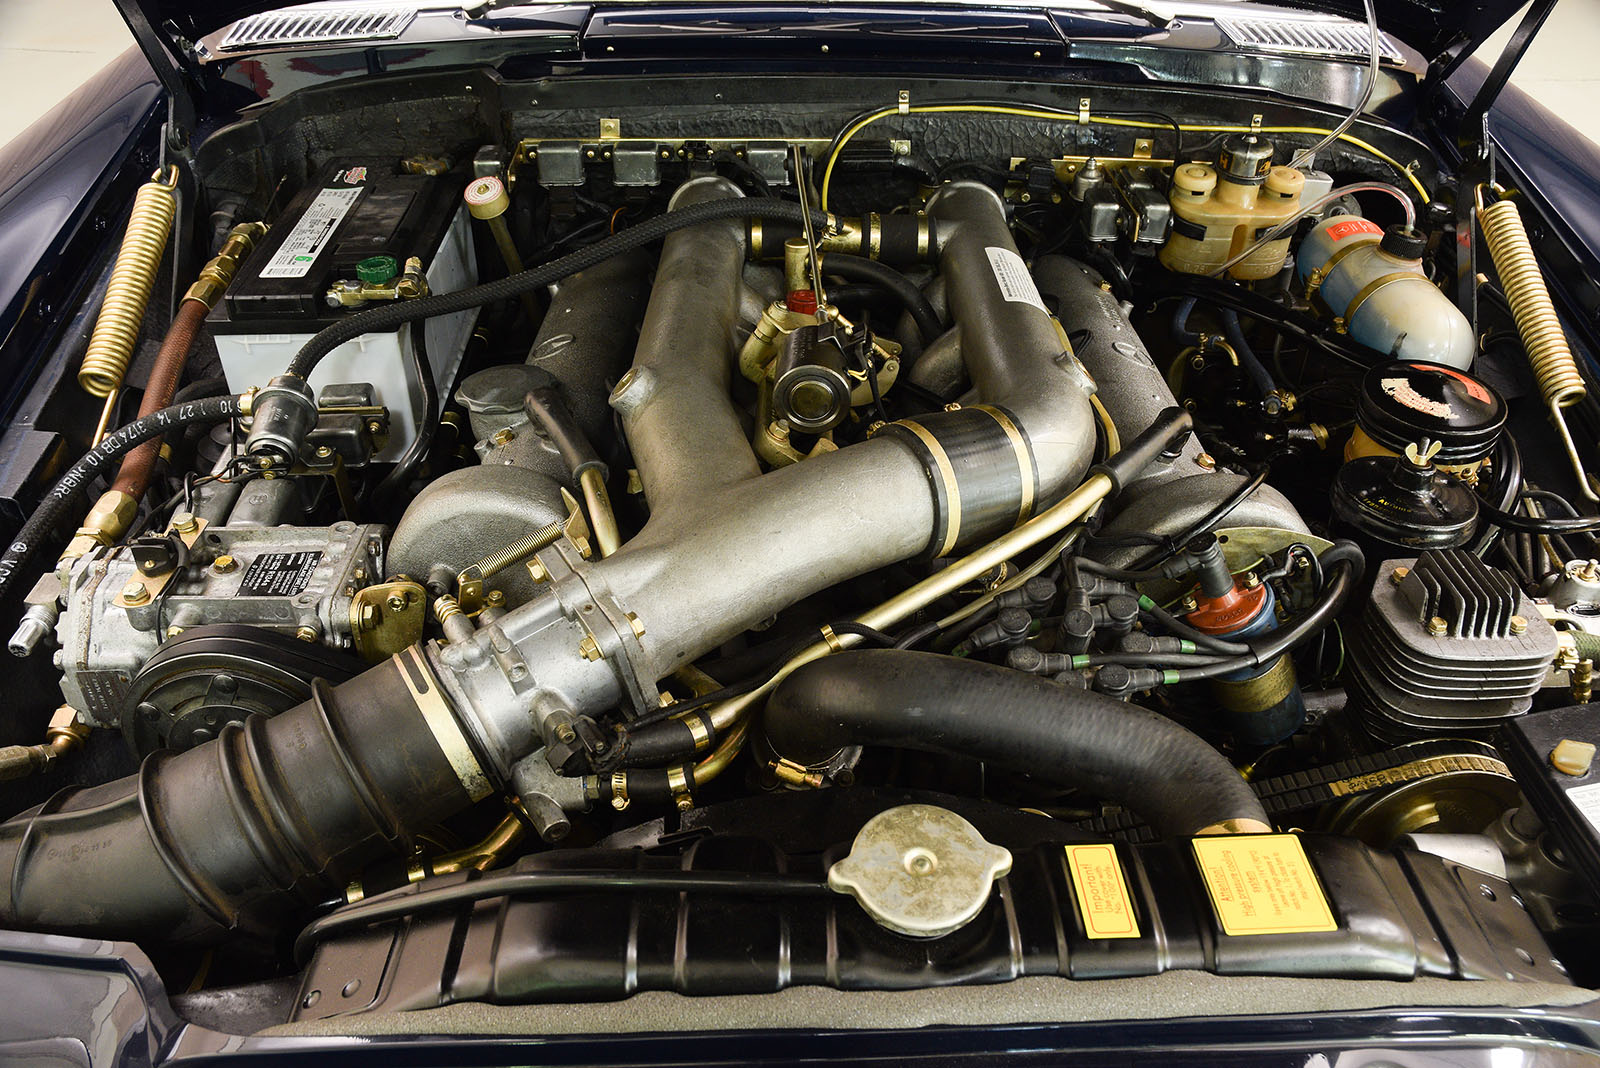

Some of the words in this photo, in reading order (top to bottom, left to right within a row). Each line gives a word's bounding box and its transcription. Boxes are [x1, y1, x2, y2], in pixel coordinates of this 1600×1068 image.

[179, 404, 194, 420] 27
[220, 400, 233, 413] 10
[156, 412, 171, 426] 14
[86, 450, 103, 466] 10
[1218, 849, 1239, 872] cooling
[1094, 865, 1104, 879] with
[1079, 863, 1102, 914] Important!
[1098, 879, 1109, 898] cover
[1209, 866, 1230, 902] Attention!
[1229, 872, 1248, 899] pressure
[1243, 870, 1262, 893] system
[1102, 899, 1114, 912] Use
[1238, 900, 1256, 916] High
